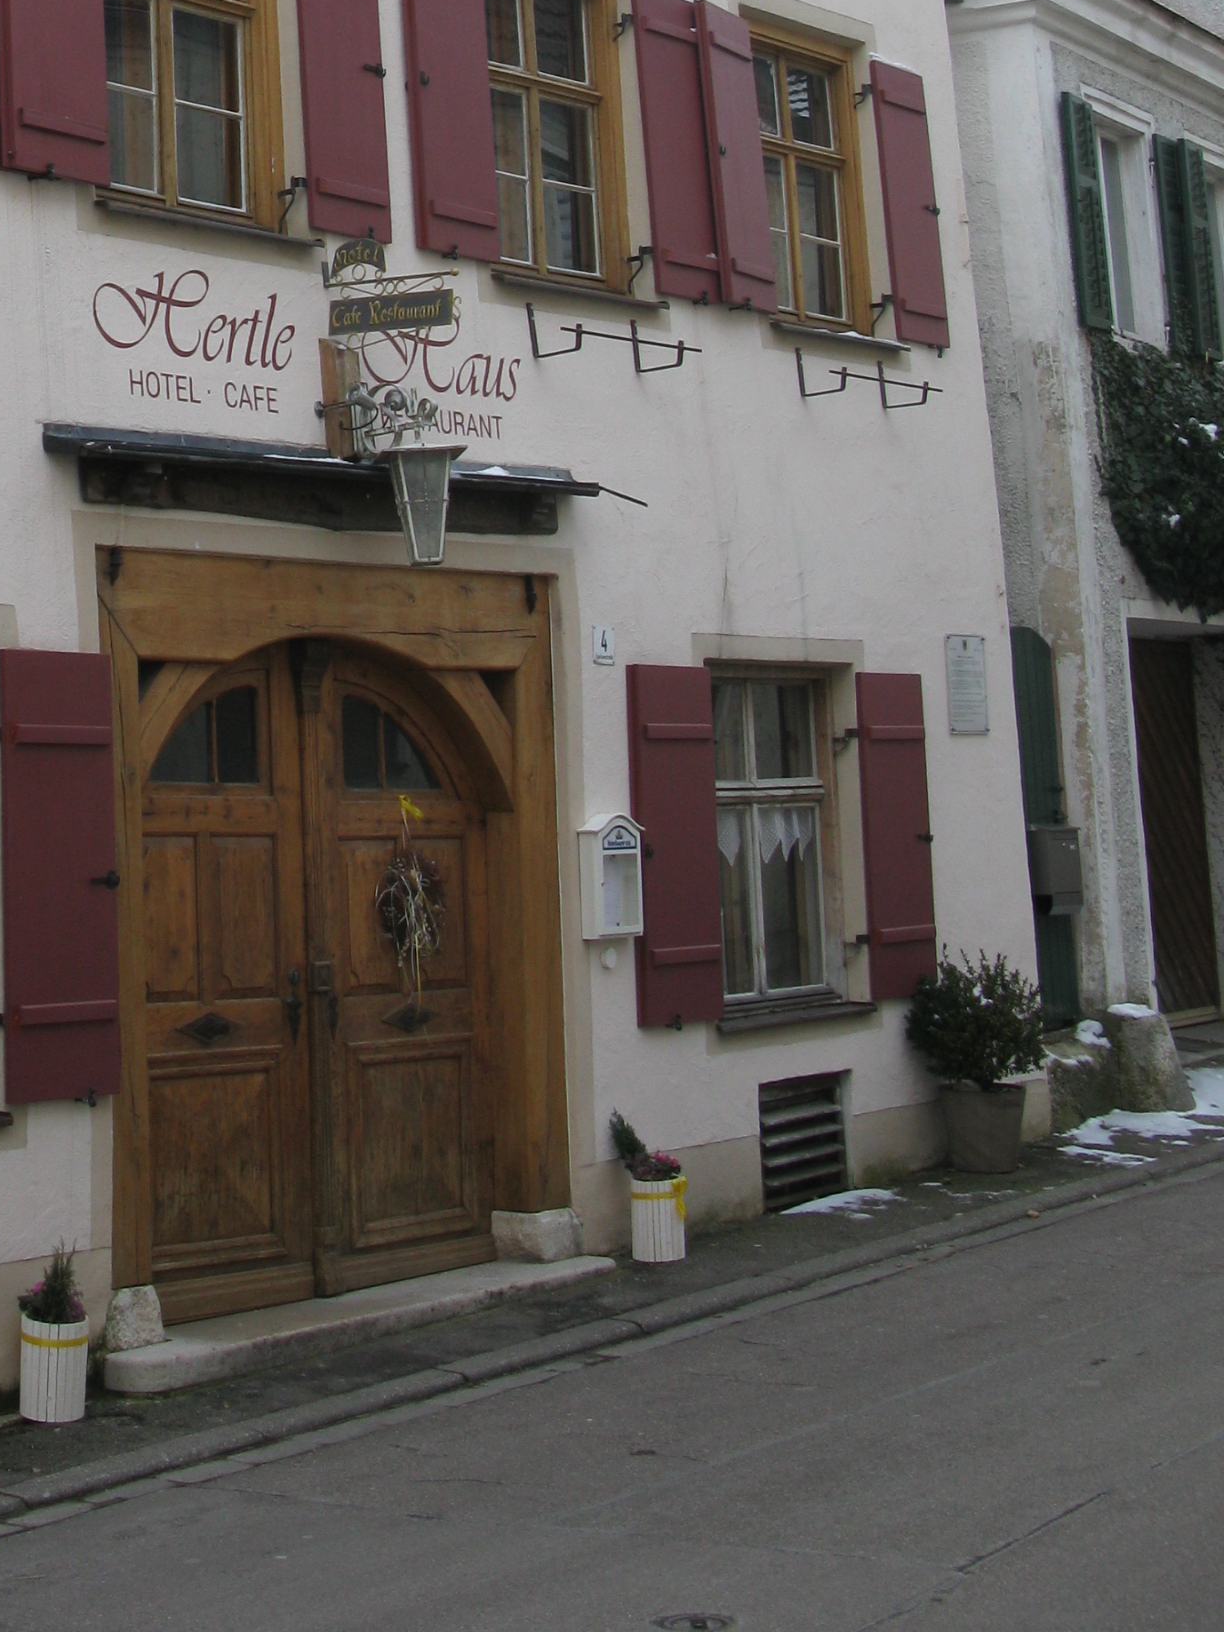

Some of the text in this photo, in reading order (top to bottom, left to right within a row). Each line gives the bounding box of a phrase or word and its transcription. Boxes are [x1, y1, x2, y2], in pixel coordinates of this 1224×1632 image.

[334, 241, 381, 270] Hotel
[93, 270, 295, 371] Hertle
[332, 297, 442, 328] Cafe Restaurant
[129, 369, 201, 404] HOTEL
[224, 382, 279, 414] CAFE
[600, 629, 608, 653] 4
